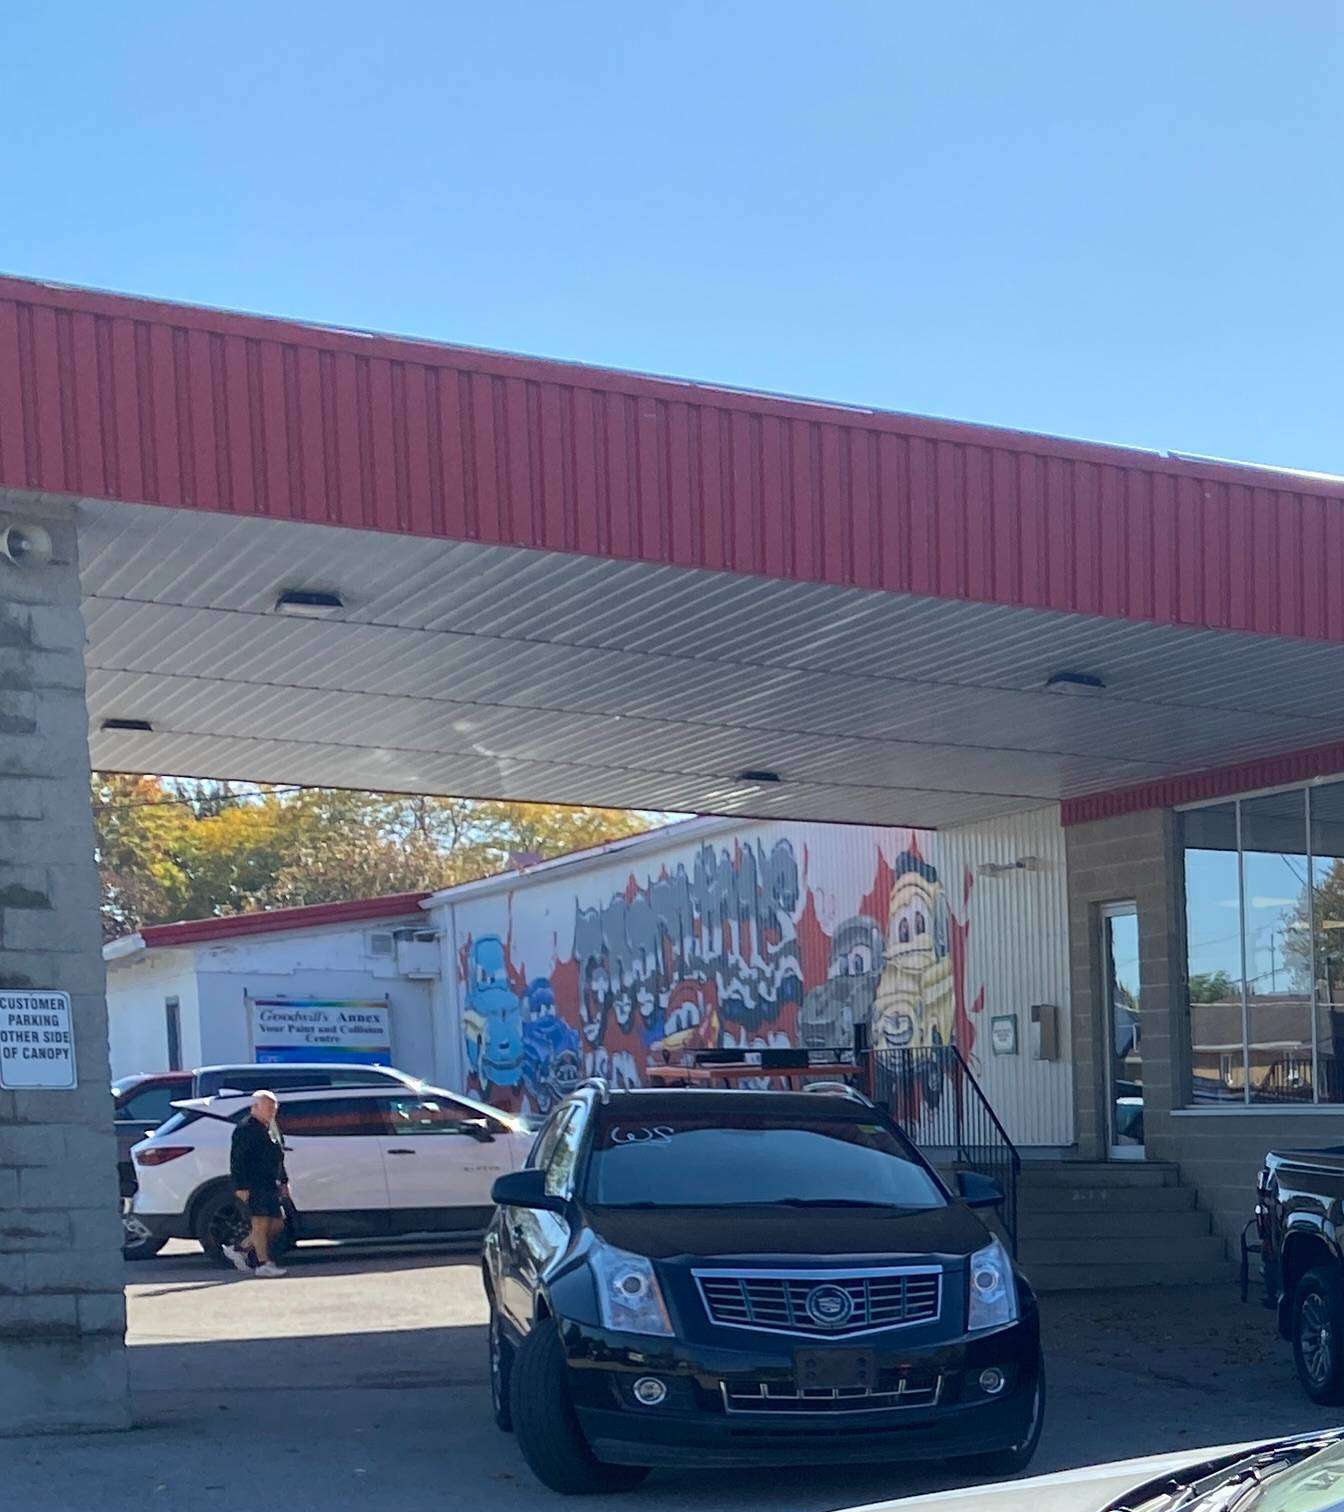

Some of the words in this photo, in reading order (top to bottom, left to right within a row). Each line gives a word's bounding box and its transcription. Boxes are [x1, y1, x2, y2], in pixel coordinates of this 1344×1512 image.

[0, 997, 65, 1010] CUSTOMER
[8, 1014, 59, 1027] PARKING
[337, 1011, 381, 1023] Annex
[258, 1023, 284, 1033] Your
[287, 1024, 315, 1034] Paint
[318, 1024, 337, 1034] and
[0, 1030, 39, 1043] OTHER
[43, 1031, 69, 1043] SIDE
[305, 1034, 341, 1044] Centre
[3, 1047, 17, 1059] OF
[23, 1047, 69, 1060] CANOPY
